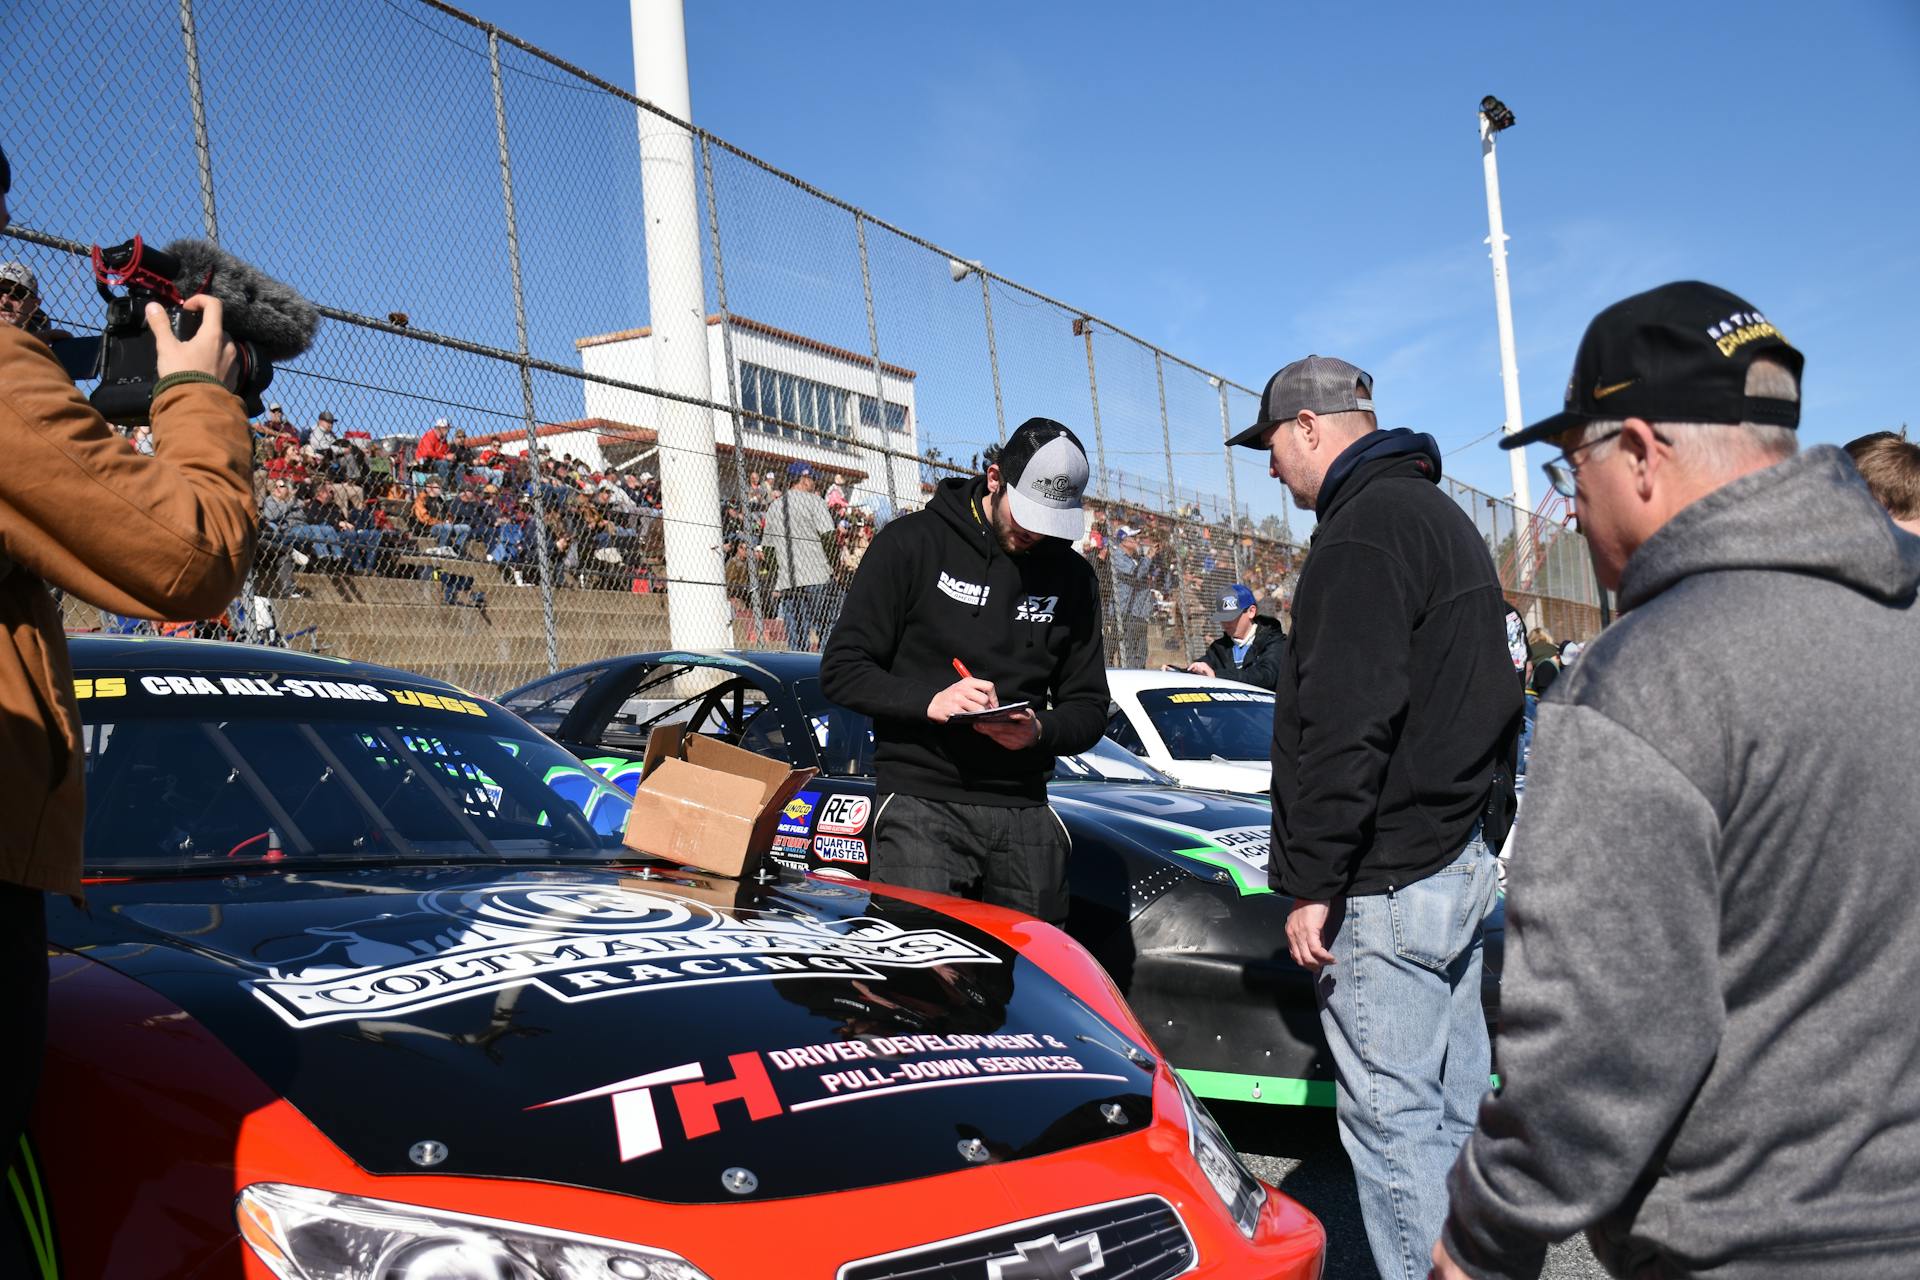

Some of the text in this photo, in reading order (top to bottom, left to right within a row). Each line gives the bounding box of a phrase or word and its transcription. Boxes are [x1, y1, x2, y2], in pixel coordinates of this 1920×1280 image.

[1707, 312, 1766, 339] NATIO
[140, 676, 389, 703] CRA ALL-STARS
[385, 688, 488, 718] JEGS
[785, 803, 812, 814] UNOCO
[777, 823, 809, 834] ACE FUELS
[1214, 829, 1271, 847] DEAL
[815, 836, 863, 851] QUARTER
[823, 848, 865, 862] MASTER
[316, 932, 945, 1004] COLTMAN FARMS
[563, 955, 852, 990] RACING
[767, 1033, 1068, 1072] DRIVER DEVELOPMENT &
[819, 1054, 1085, 1094] PULL-DOWN SERVICES
[523, 1050, 783, 1163] TH
